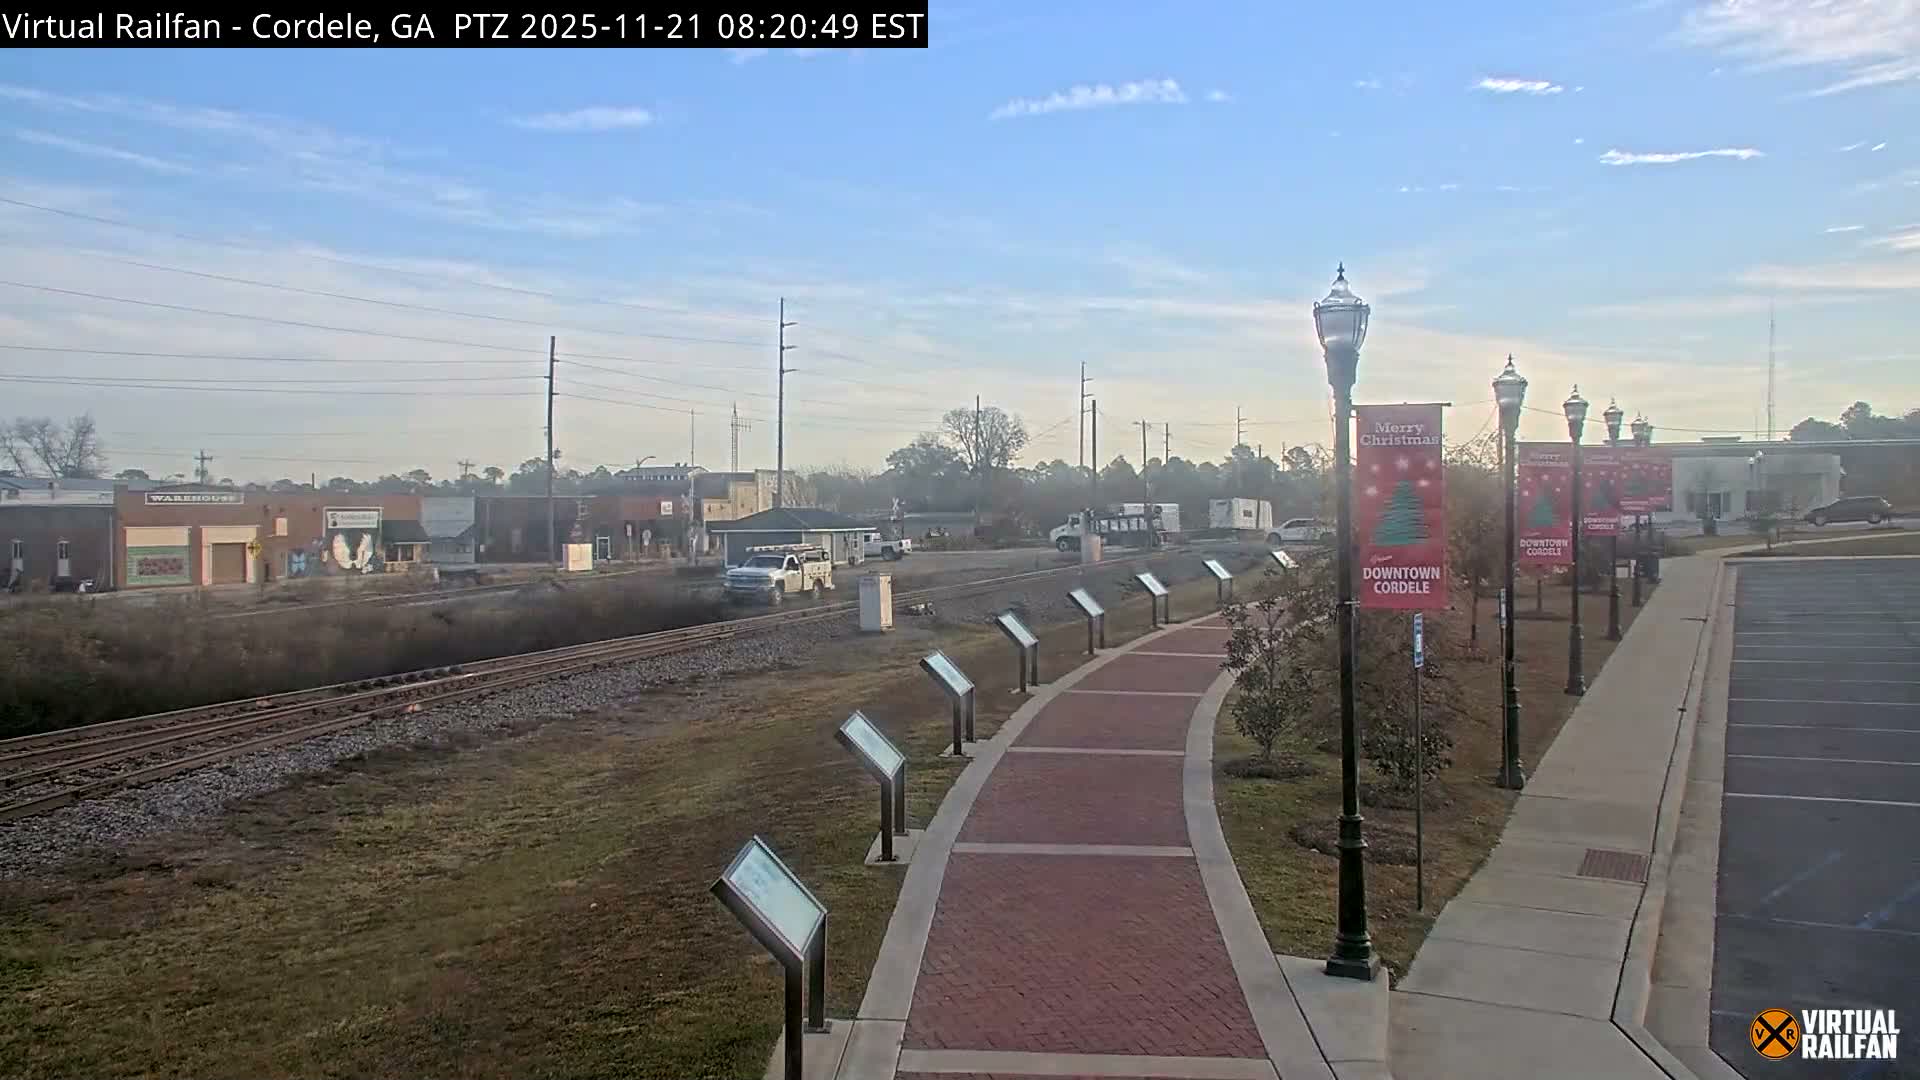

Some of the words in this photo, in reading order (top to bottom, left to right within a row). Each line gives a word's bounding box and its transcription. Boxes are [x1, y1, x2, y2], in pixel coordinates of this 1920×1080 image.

[1375, 422, 1424, 435] Merry
[1360, 434, 1440, 446] Christmas
[150, 494, 237, 502] WAREHOUSE
[1519, 538, 1569, 548] DOWNTOWN
[1526, 547, 1562, 556] CORDELE
[1363, 567, 1440, 580] DOWNTOWN
[1373, 580, 1431, 594] CORDELE
